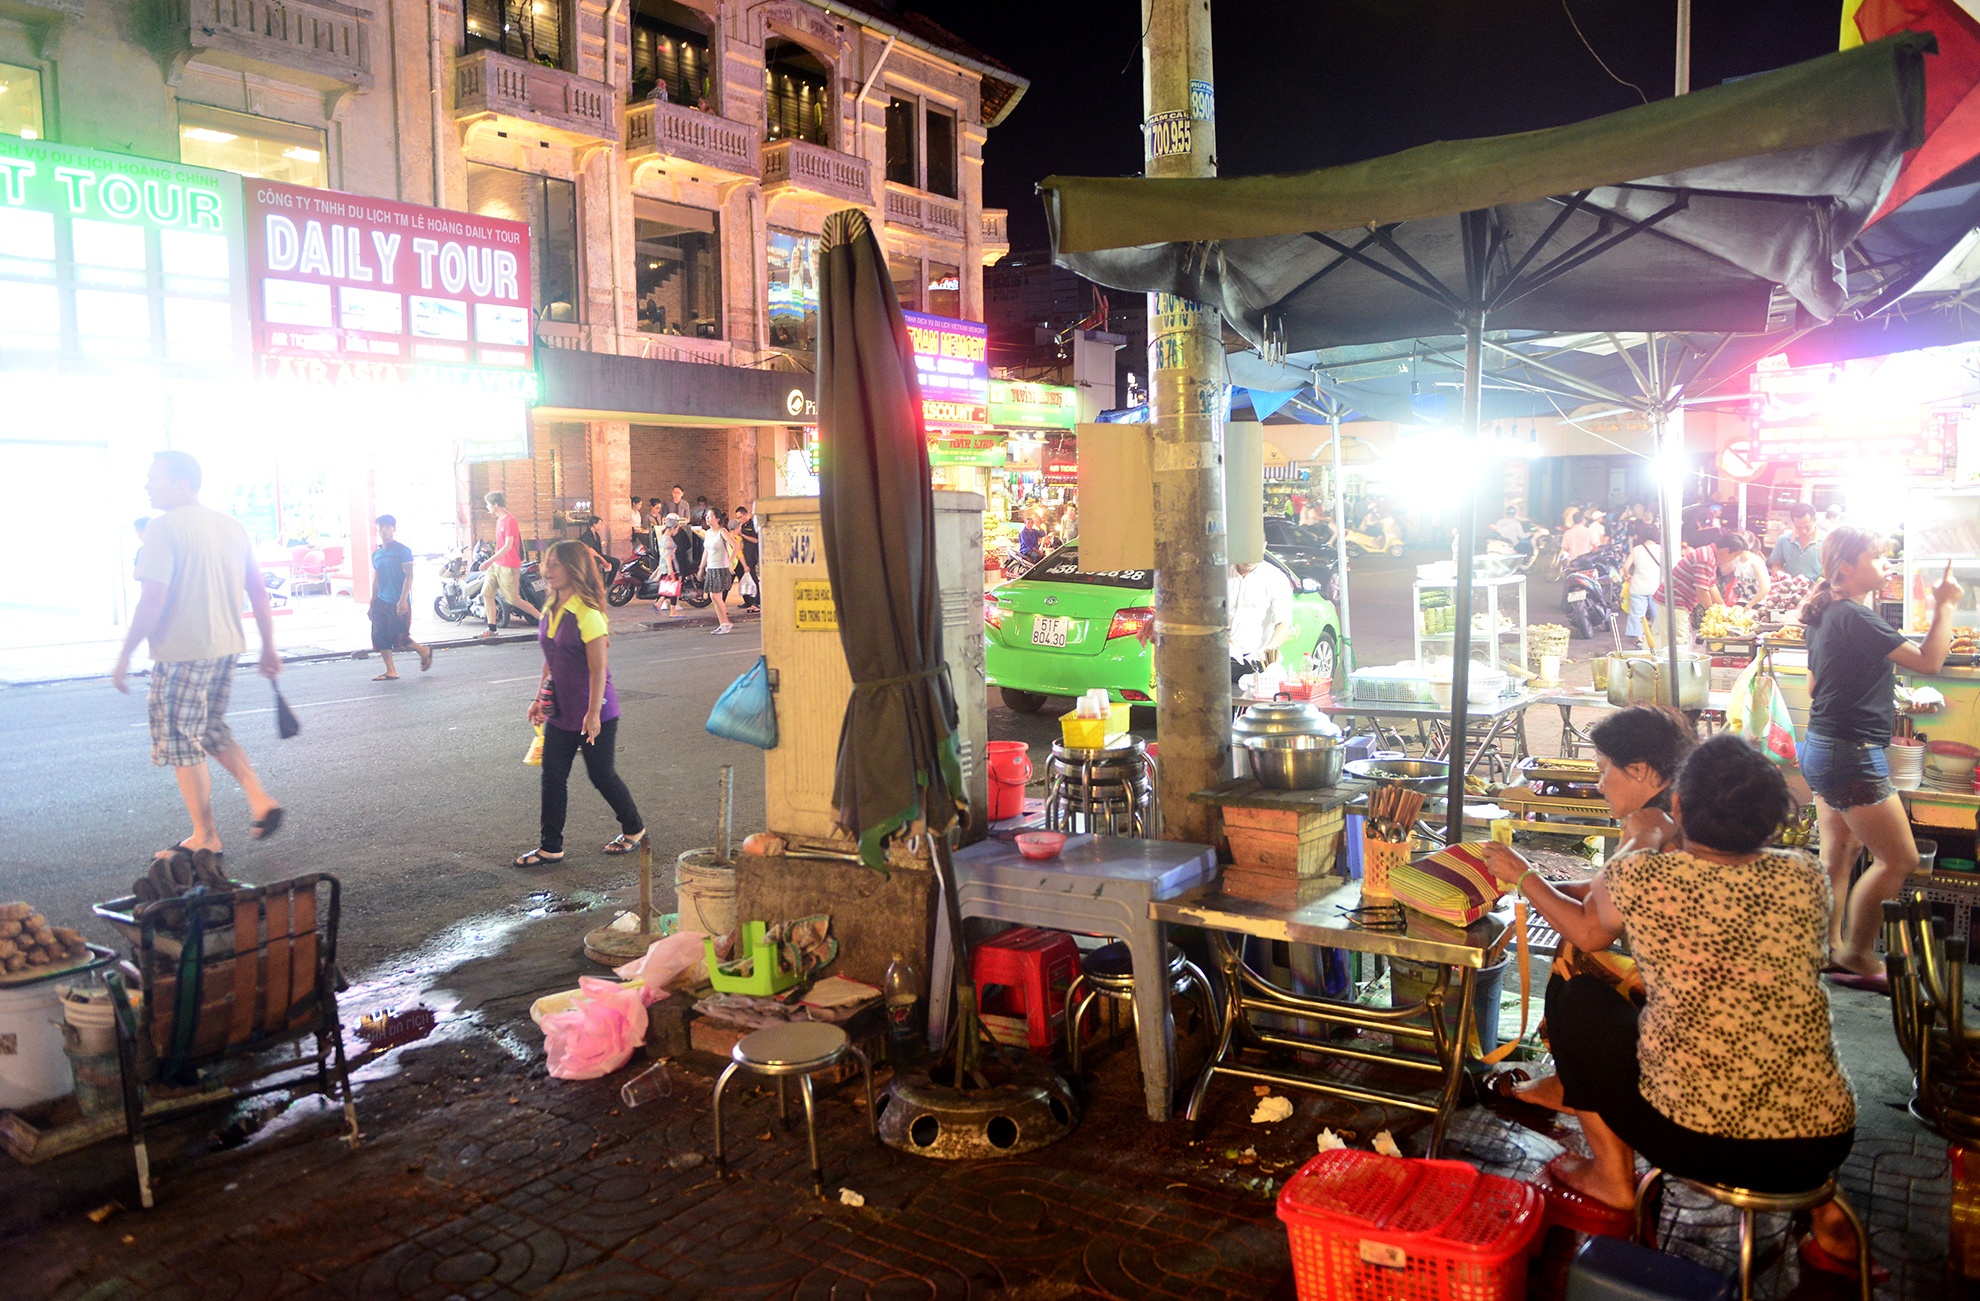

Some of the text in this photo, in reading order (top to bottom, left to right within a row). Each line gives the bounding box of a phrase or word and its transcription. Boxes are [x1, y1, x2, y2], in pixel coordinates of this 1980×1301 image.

[25, 147, 47, 162] VỤ
[51, 151, 73, 165] DU
[78, 155, 113, 171] LỊCH
[118, 158, 172, 180] HOÀNG
[176, 170, 219, 188] CHÍNH
[54, 166, 224, 232] TOUR
[257, 188, 520, 244] CÔNG TY TNHH DU LỊCH TM LÊ HOÀNG DAILY TOUR
[266, 214, 519, 300] DAILY TOUR
[940, 332, 987, 362] MEMORY
[922, 402, 975, 421] ISCOUNT
[1120, 569, 1146, 580] 28
[1033, 631, 1066, 646] 804.30
[1041, 619, 1060, 632] 51F
